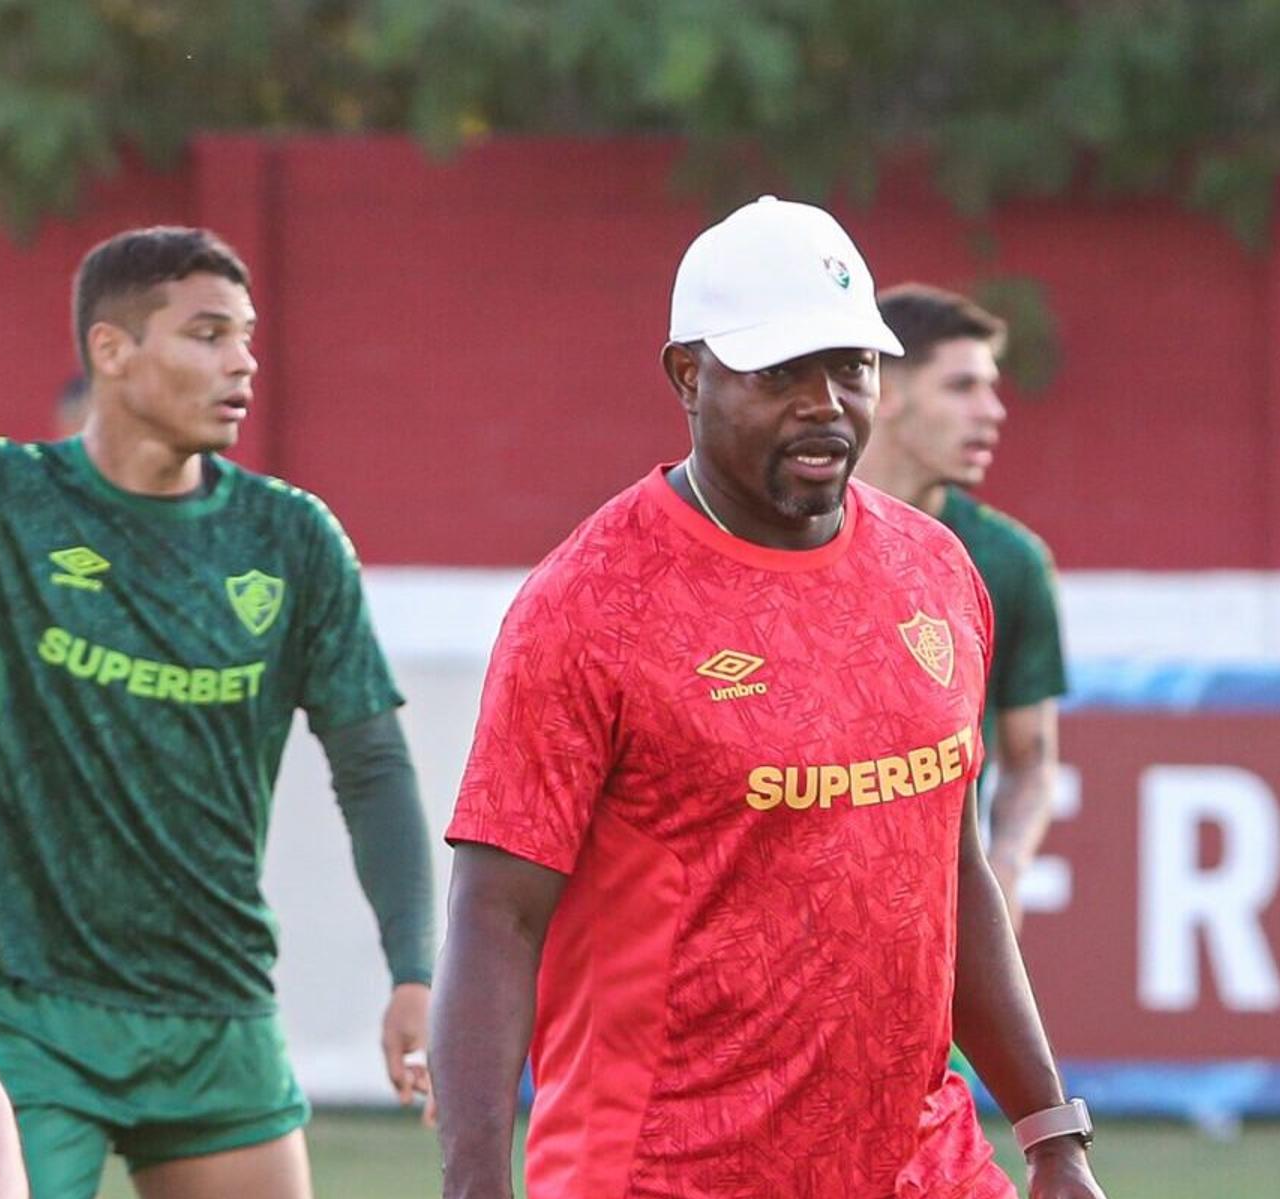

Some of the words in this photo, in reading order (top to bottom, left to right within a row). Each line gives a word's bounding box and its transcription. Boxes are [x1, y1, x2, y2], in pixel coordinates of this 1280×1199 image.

[37, 626, 267, 703] SUPERBET
[710, 682, 767, 701] umbro
[746, 725, 973, 811] SUPERBET
